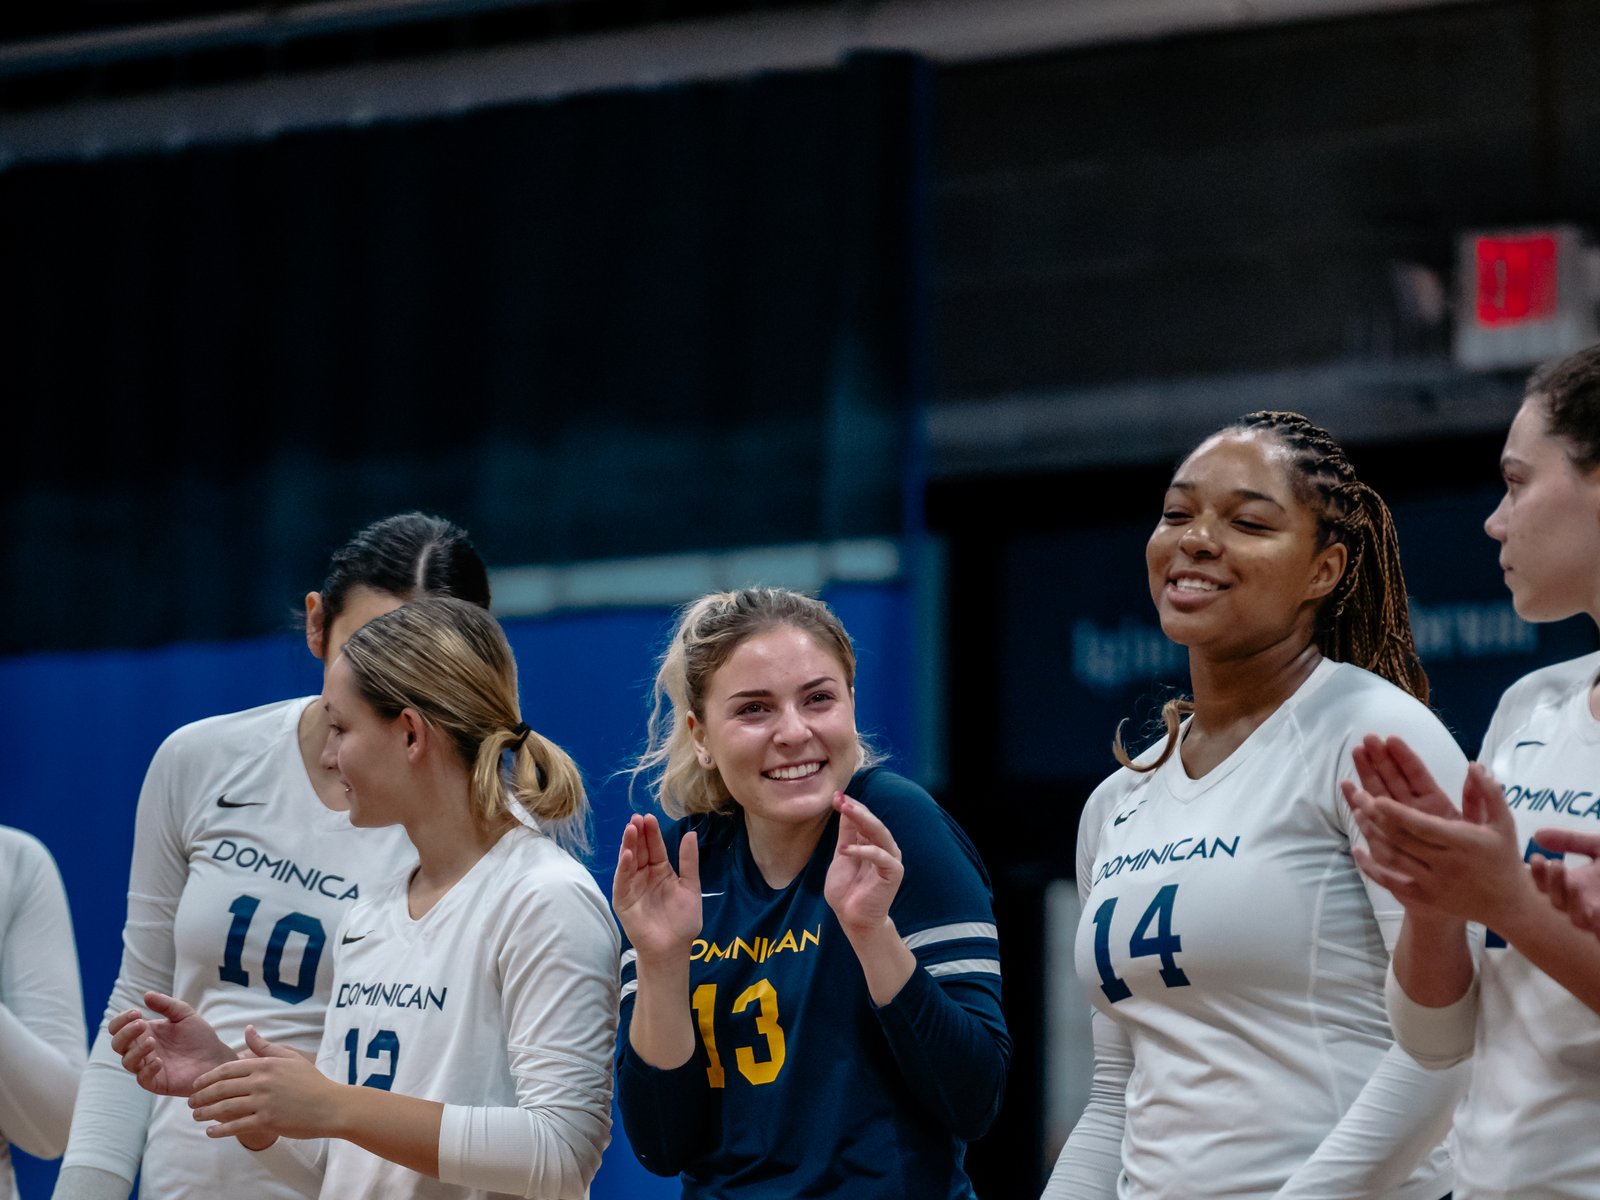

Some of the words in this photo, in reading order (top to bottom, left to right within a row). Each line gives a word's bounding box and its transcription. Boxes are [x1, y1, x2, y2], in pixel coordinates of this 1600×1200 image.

[1501, 783, 1600, 820] OMINICA
[211, 839, 359, 900] DOMINICA
[1093, 835, 1241, 887] DOMINICAN
[218, 894, 326, 1005] 10
[1092, 883, 1191, 1004] 14
[335, 982, 447, 1011] DOMINICAN
[344, 1028, 400, 1092] 12
[691, 977, 786, 1089] 13
